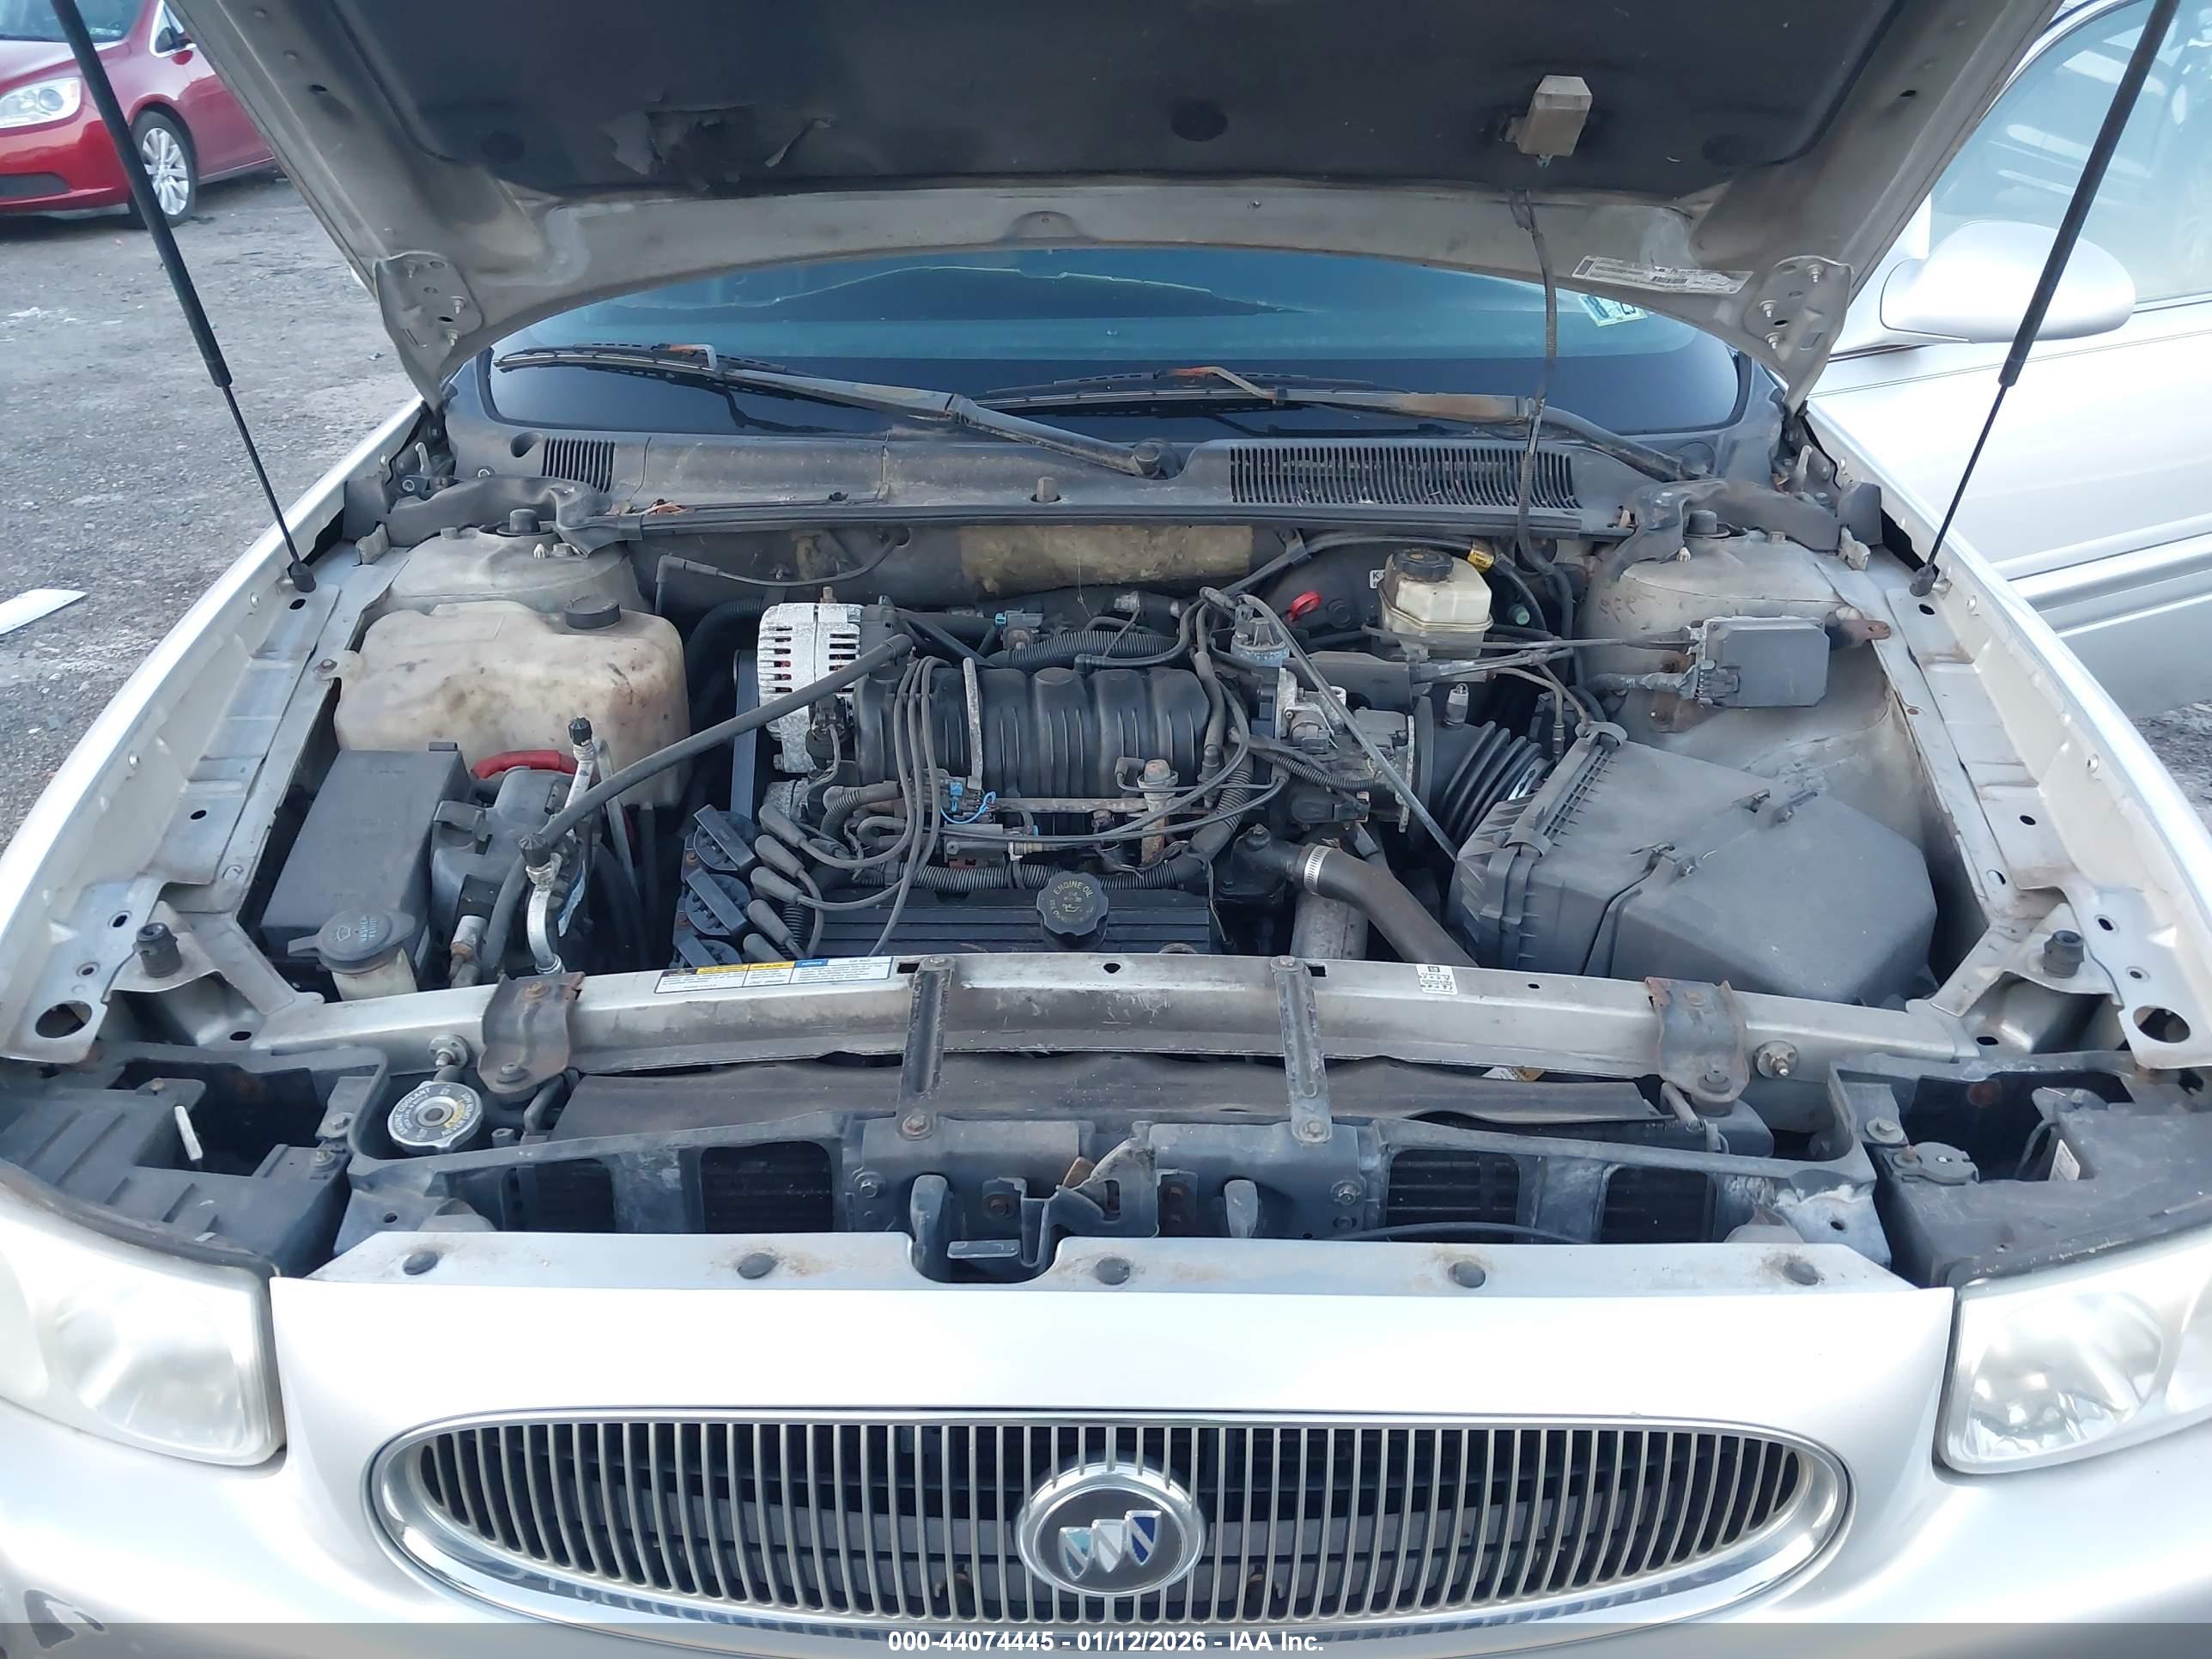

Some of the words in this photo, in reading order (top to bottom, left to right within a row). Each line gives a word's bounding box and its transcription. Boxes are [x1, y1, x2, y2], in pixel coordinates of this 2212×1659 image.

[1053, 880, 1084, 895] ENGINE
[1083, 885, 1093, 898] OIL
[398, 1086, 430, 1112] COOLANT
